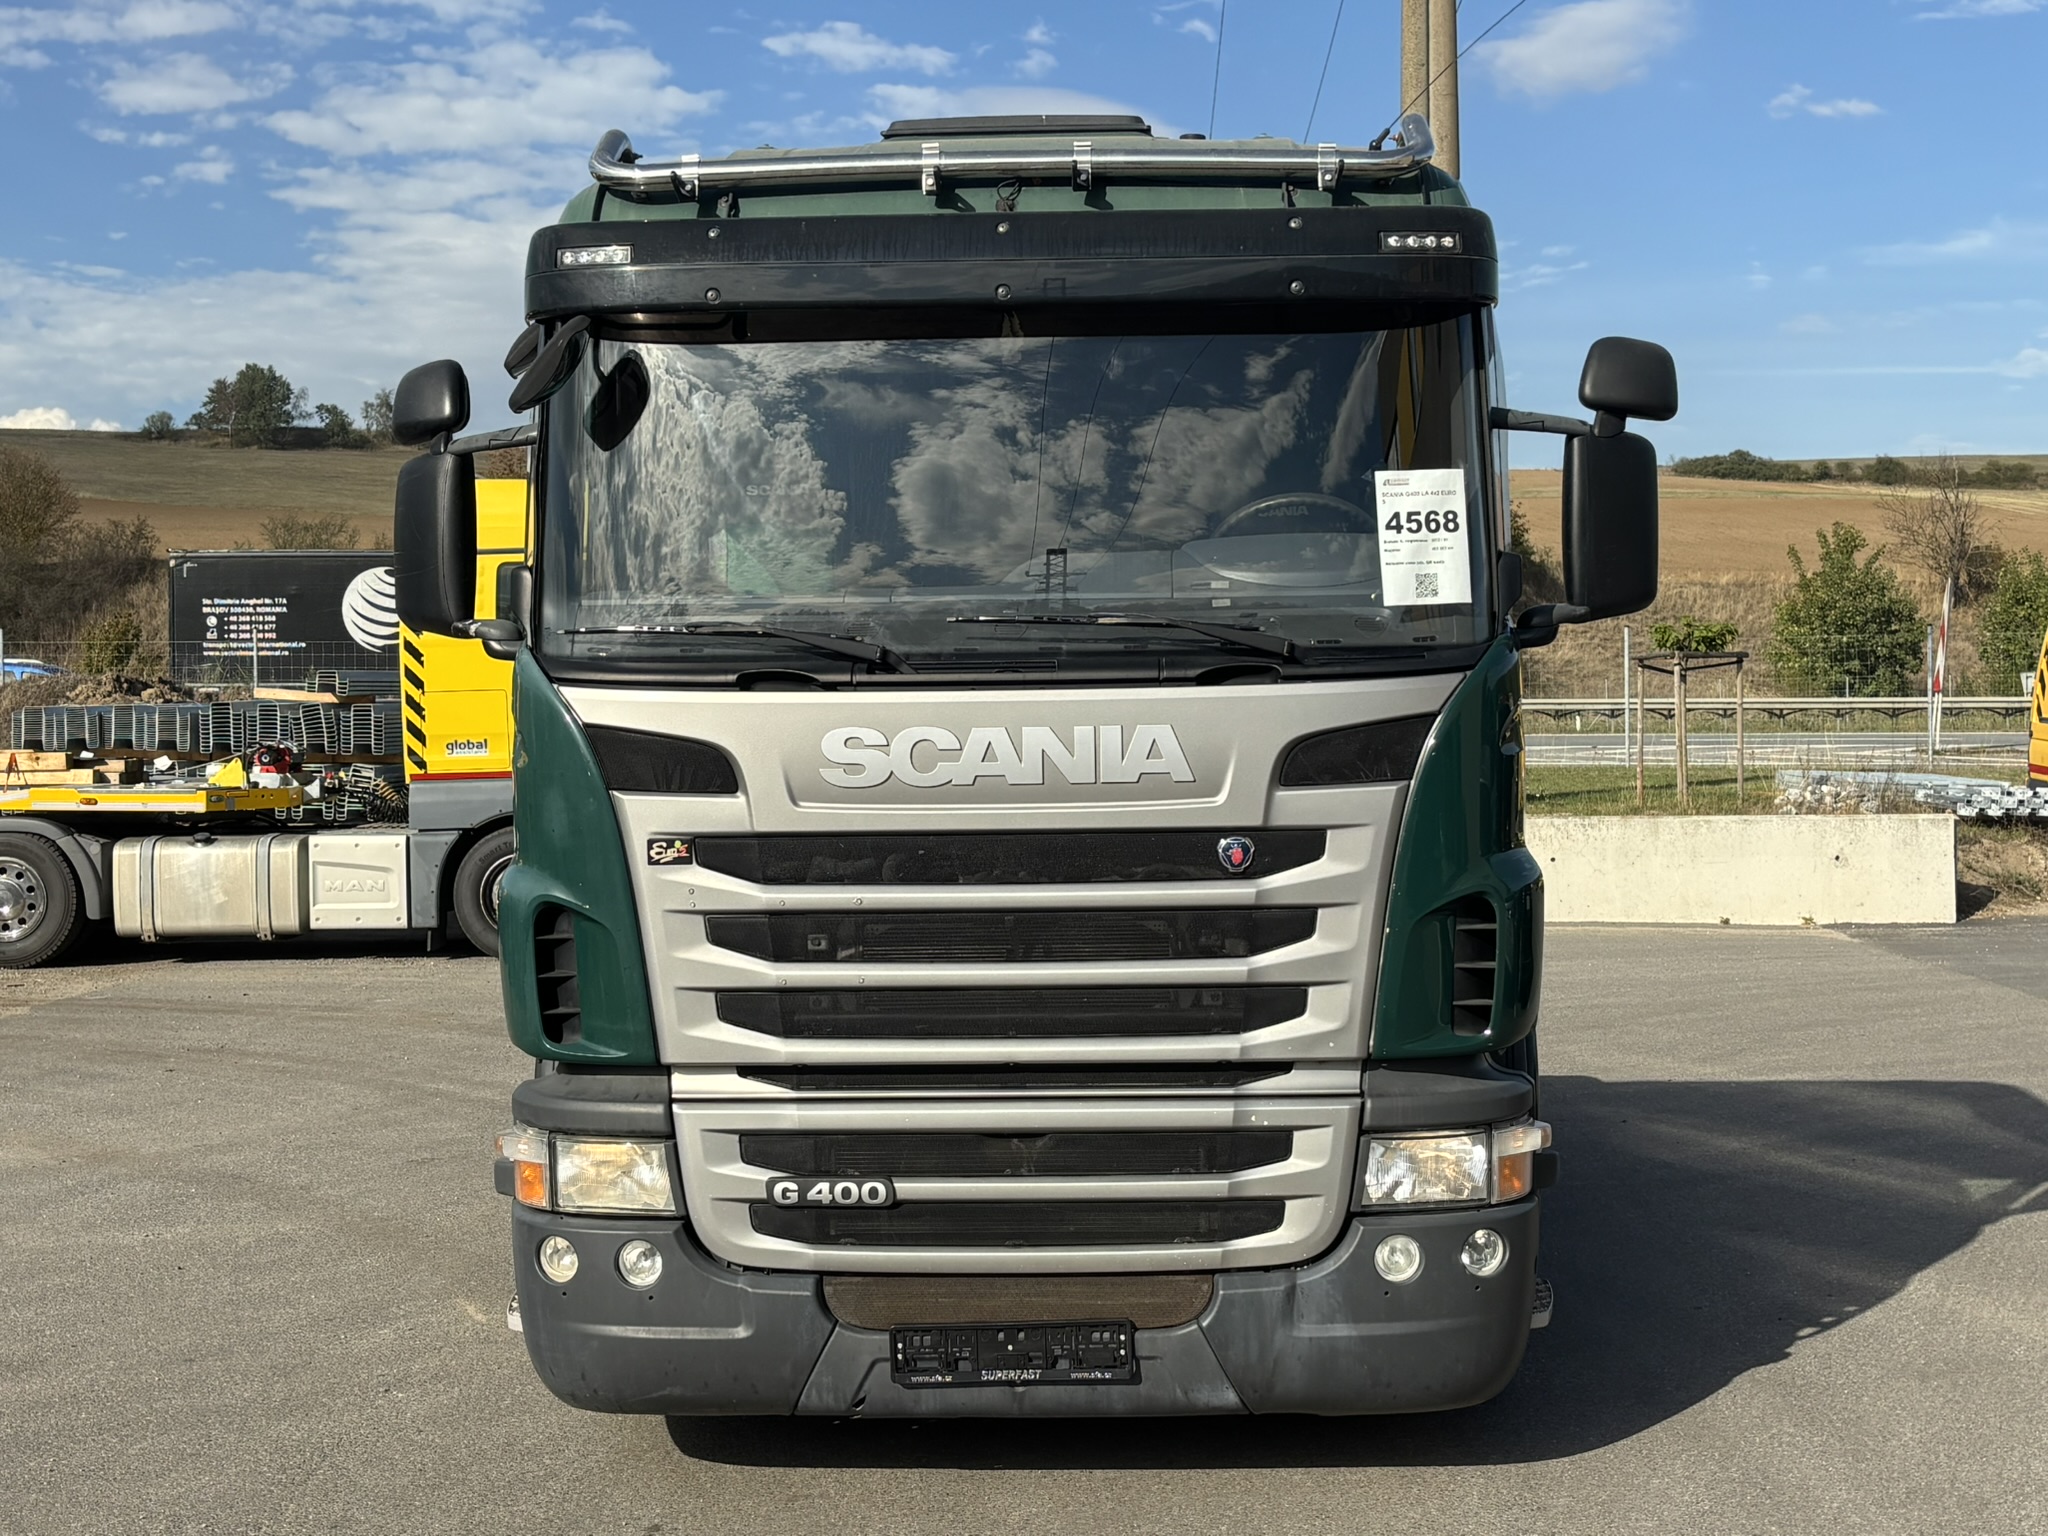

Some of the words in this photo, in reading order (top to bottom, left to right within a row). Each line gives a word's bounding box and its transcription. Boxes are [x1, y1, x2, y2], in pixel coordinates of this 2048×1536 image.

[1385, 510, 1460, 534] 4568
[445, 738, 488, 755] global
[818, 724, 1197, 789] SCANIA
[324, 880, 386, 893] MAN
[773, 1181, 798, 1204] G
[806, 1181, 886, 1204] 400
[980, 1369, 1042, 1381] SUPERFAST
